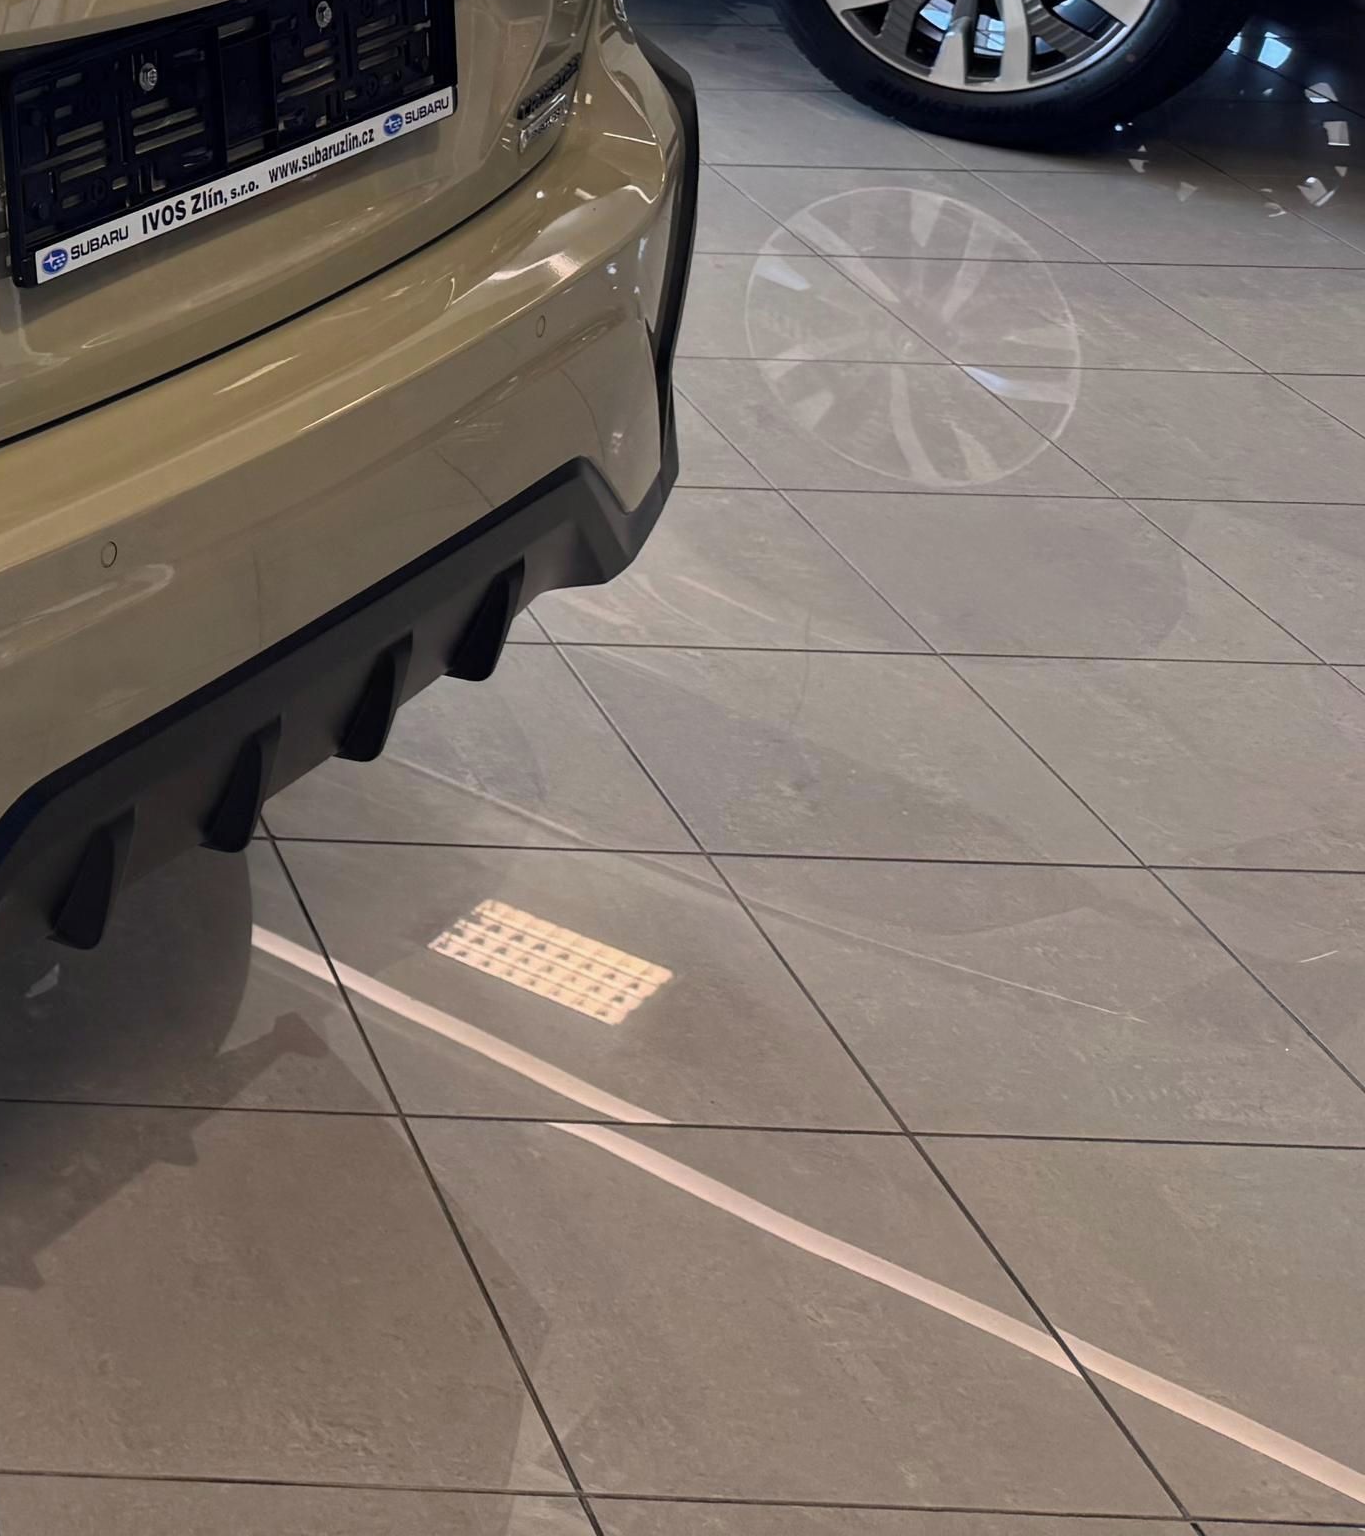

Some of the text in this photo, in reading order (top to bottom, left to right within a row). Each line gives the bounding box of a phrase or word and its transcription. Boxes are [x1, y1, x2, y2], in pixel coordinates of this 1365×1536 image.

[70, 96, 450, 260] SUBARU IVOS Zlín, s.r.o. www.subaruzlin.cz SUBARU
